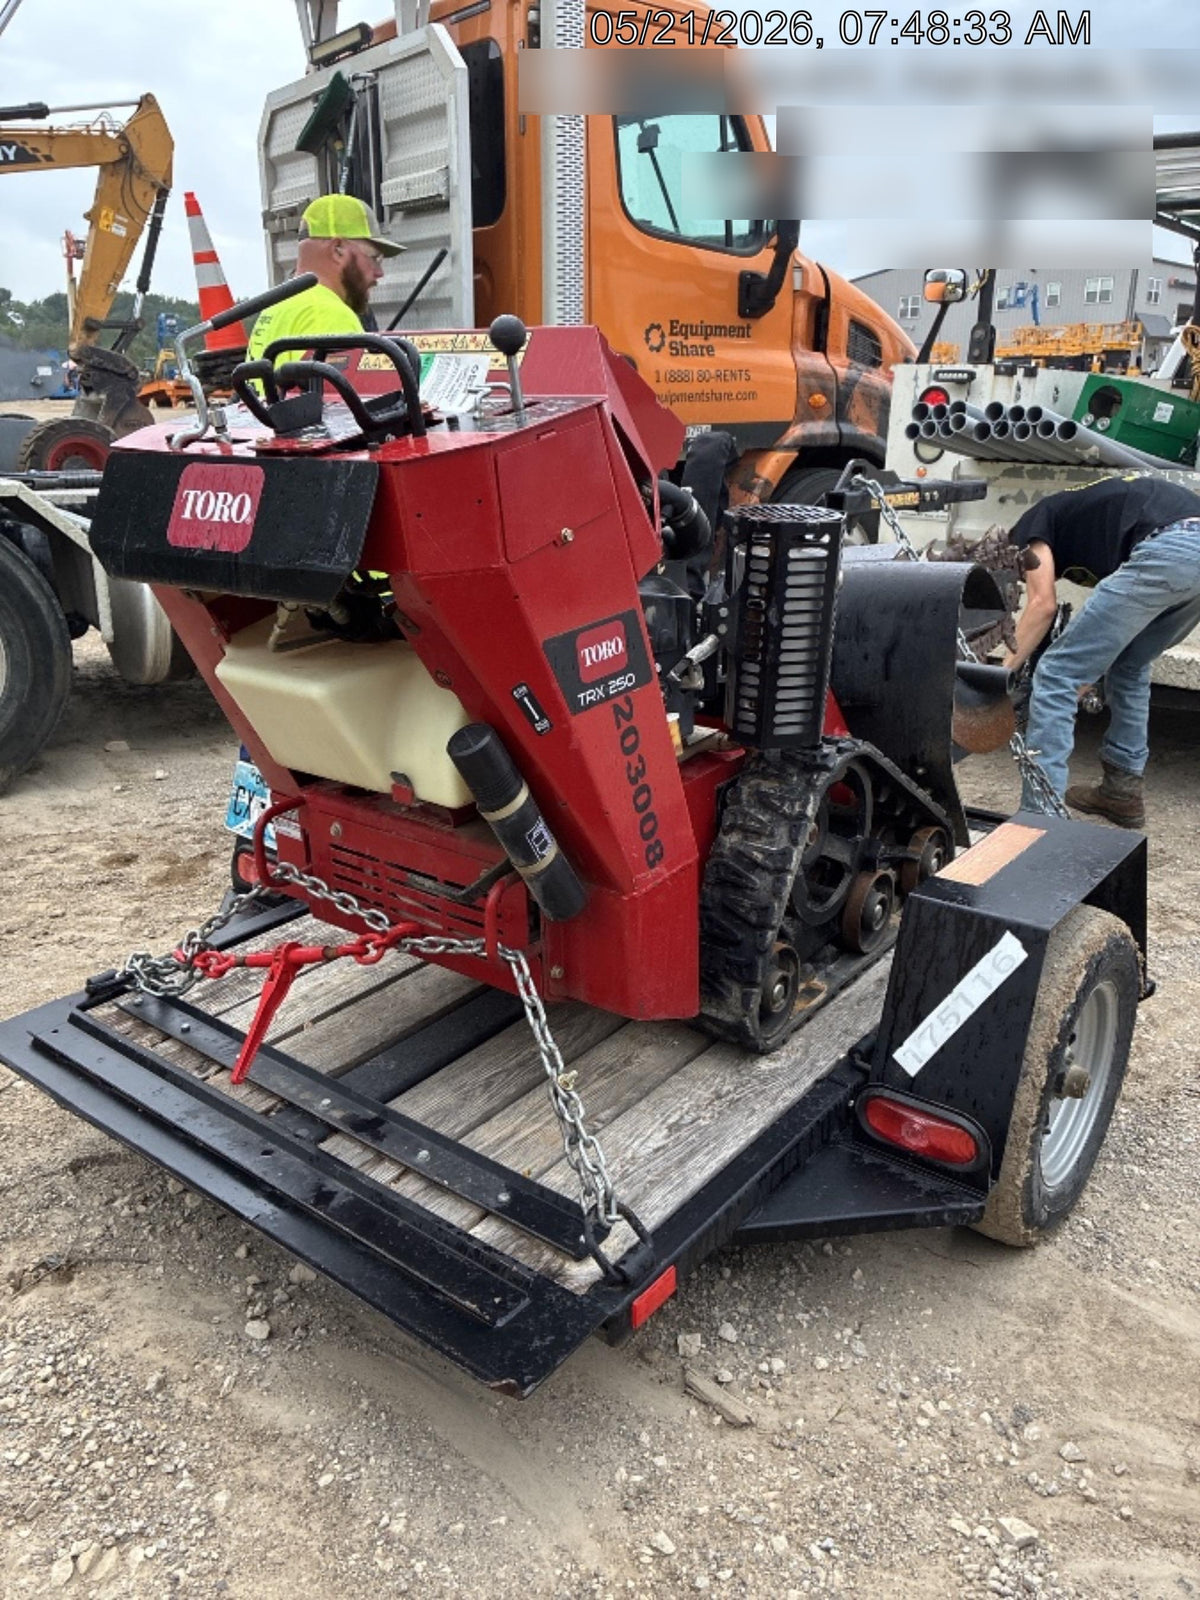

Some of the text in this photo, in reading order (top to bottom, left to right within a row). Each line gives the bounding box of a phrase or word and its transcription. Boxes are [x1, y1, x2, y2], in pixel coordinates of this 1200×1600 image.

[669, 319, 752, 340] Equipment
[669, 341, 715, 357] Share
[656, 369, 751, 384] 1 (888) 80-RENTS
[181, 490, 252, 524] TORO
[581, 635, 624, 668] TORO
[577, 673, 636, 706] TRX 250
[613, 694, 664, 869] 203008
